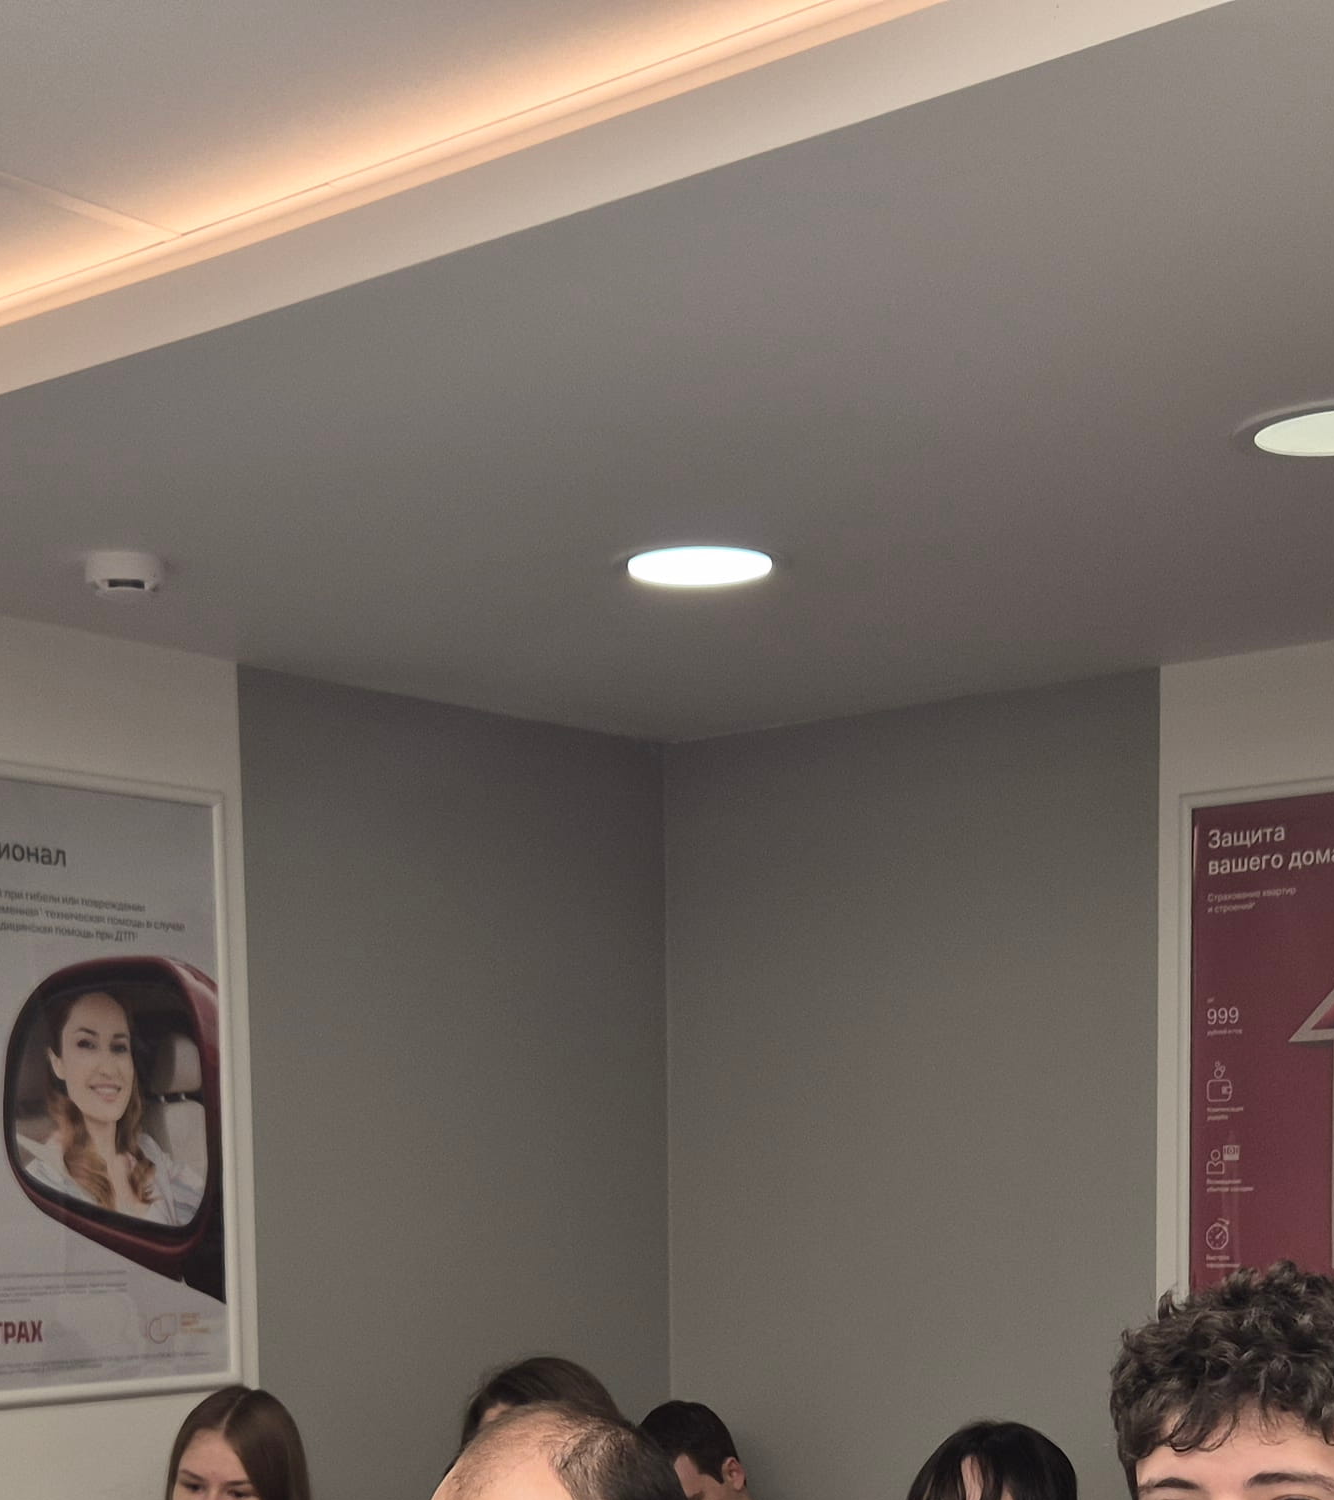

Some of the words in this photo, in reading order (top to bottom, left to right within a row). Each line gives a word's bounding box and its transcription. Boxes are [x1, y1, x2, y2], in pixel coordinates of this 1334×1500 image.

[1207, 823, 1286, 849] Защита
[1207, 852, 1284, 876] вашего
[1206, 1006, 1239, 1025] 999
